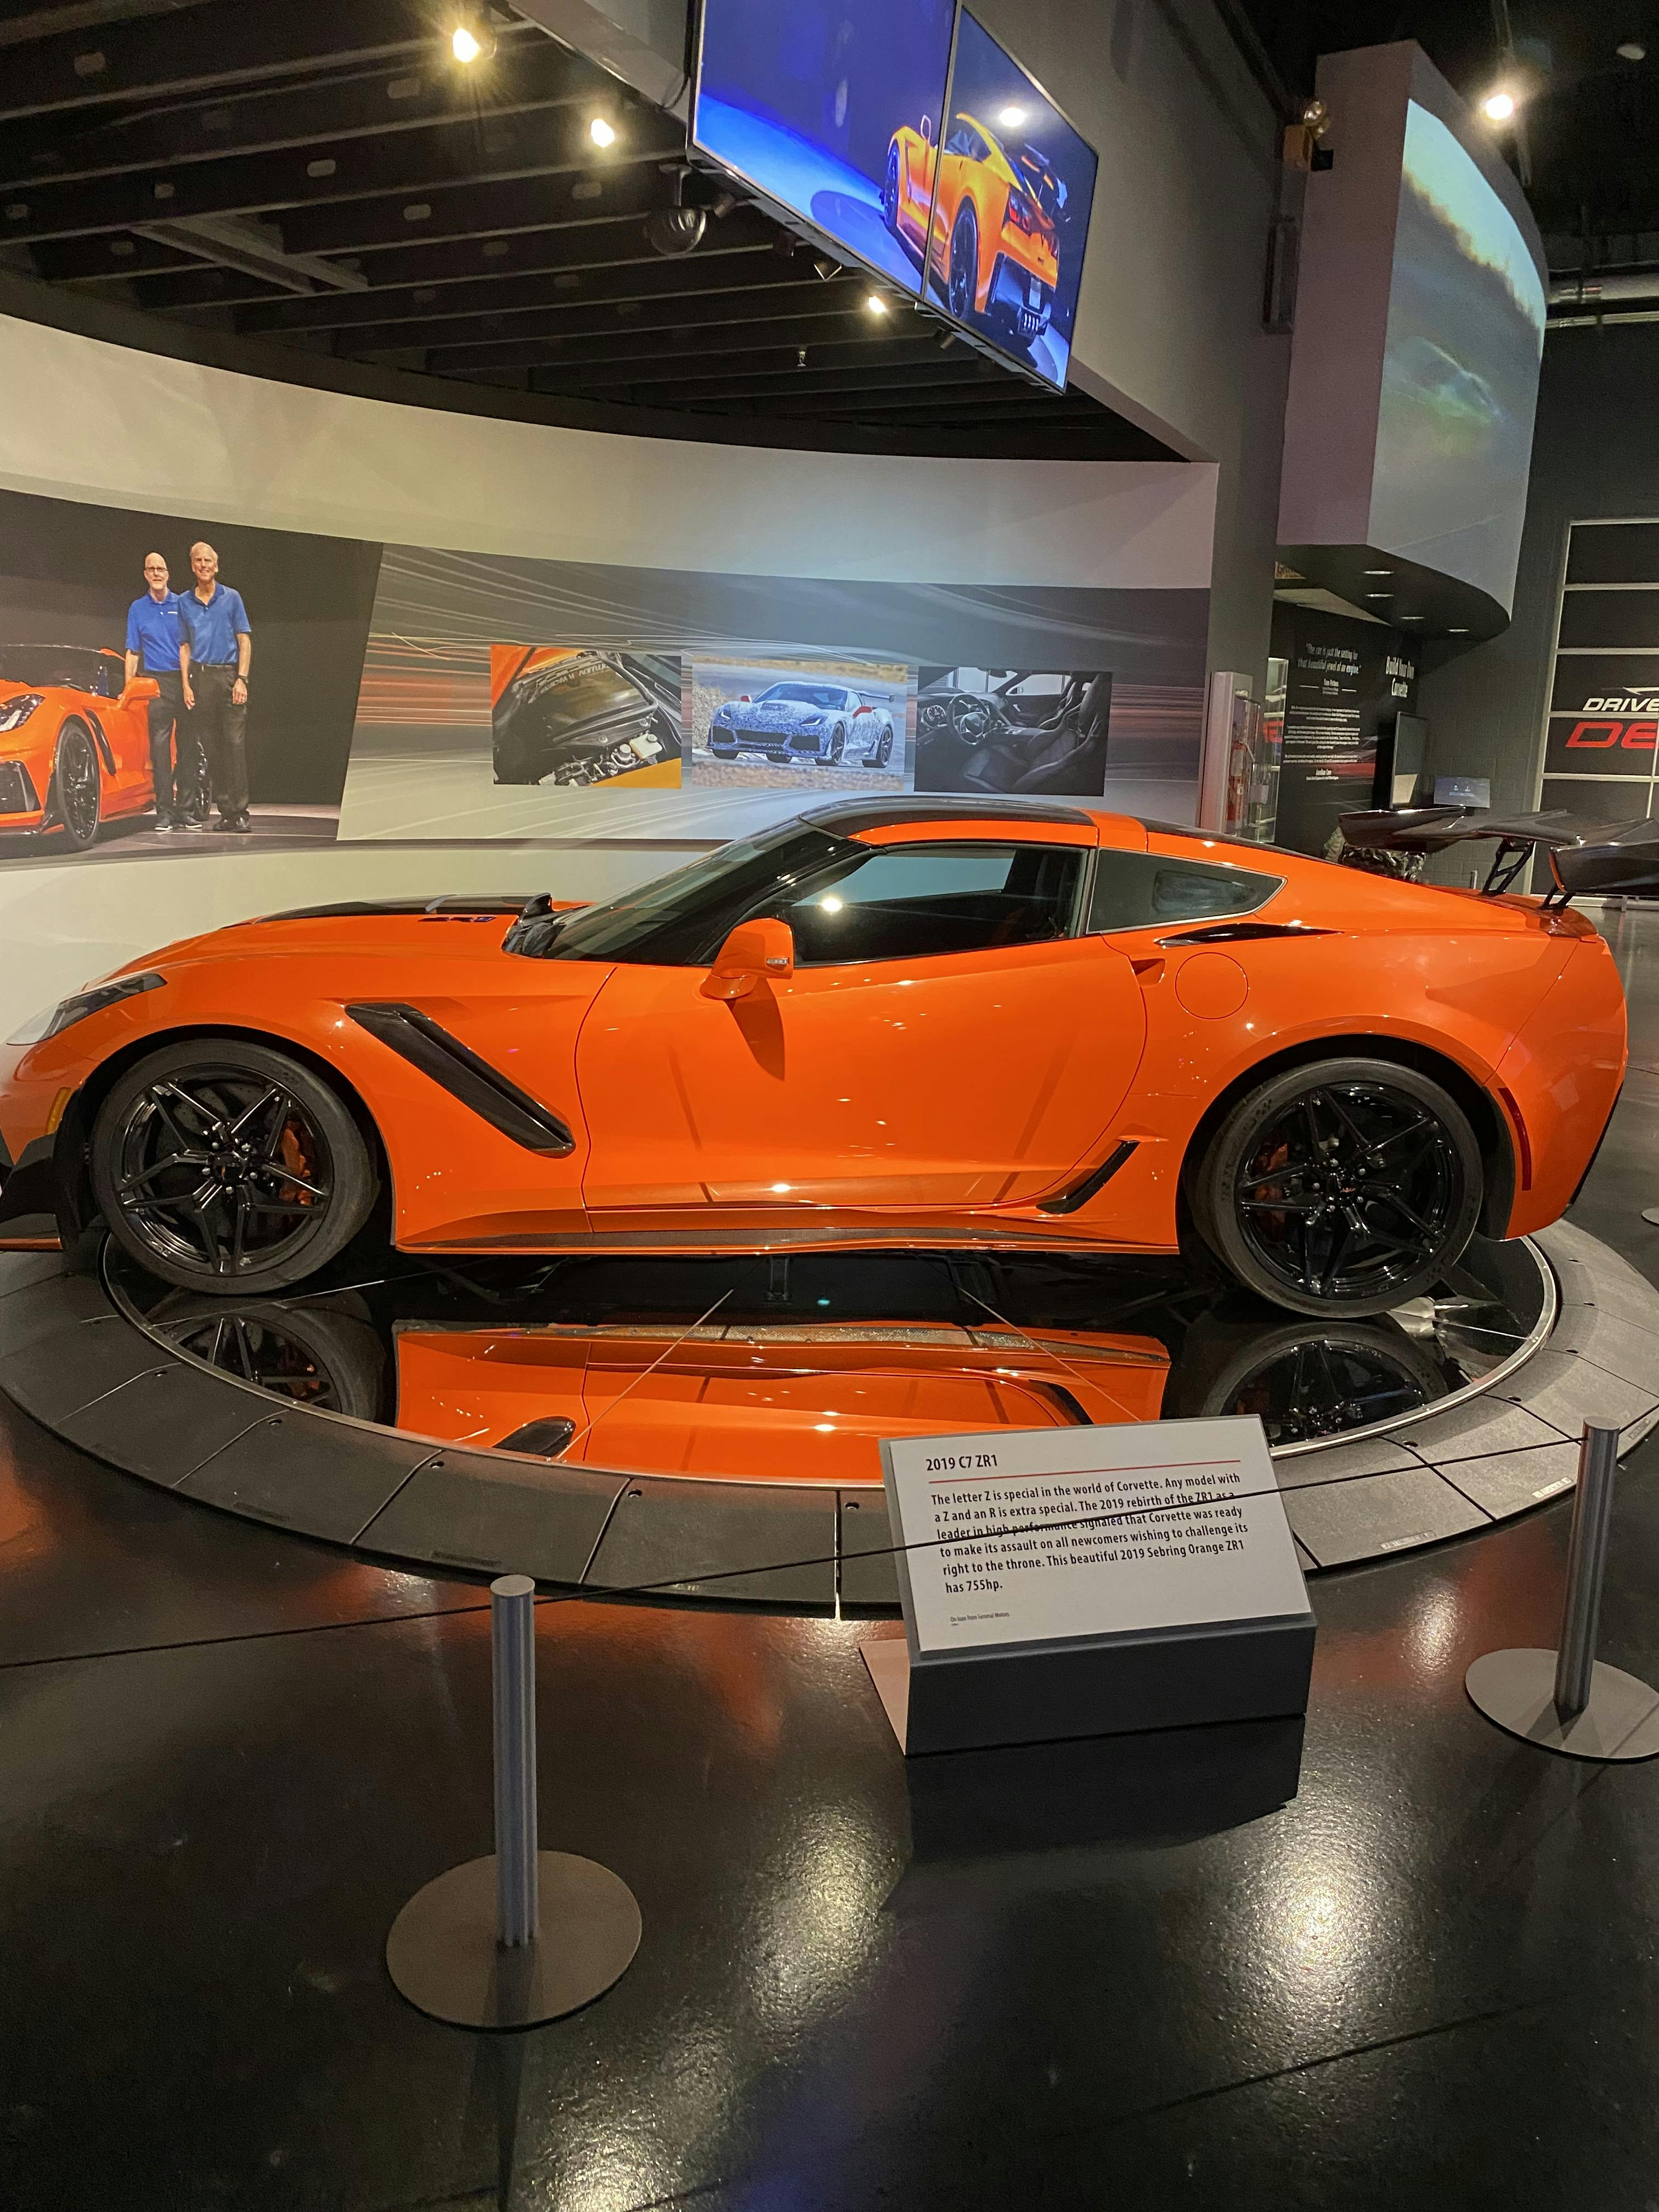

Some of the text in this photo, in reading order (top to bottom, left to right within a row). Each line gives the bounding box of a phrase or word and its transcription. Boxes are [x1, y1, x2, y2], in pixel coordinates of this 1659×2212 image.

[926, 1454, 997, 1471] 2019 C7 ZR1
[932, 1472, 1240, 1505] The letter Z is special in the world of Corvette. Any model with
[935, 1514, 940, 1522] a
[943, 1511, 949, 1521] Z
[952, 1509, 971, 1520] and
[974, 1510, 986, 1519] an
[990, 1508, 996, 1518] R
[998, 1507, 1007, 1517] is
[1009, 1505, 1036, 1516] extra
[1039, 1502, 1077, 1516] special.
[1079, 1500, 1097, 1511] The
[1101, 1498, 1124, 1510] 2019
[1127, 1496, 1162, 1508] rebirth
[1165, 1494, 1174, 1504] of
[1177, 1493, 1194, 1503] the
[1195, 1492, 1212, 1502] ZR1
[937, 1528, 970, 1539] leader
[973, 1526, 983, 1536] in
[986, 1523, 1008, 1537] high
[1080, 1516, 1122, 1530] signaled
[1125, 1514, 1147, 1525] that
[1149, 1510, 1191, 1523] Corvette
[1194, 1510, 1212, 1519] was
[1215, 1506, 1242, 1518] ready
[940, 1522, 1248, 1557] to make its assault on all newcomers wishing to challenge its
[943, 1540, 1244, 1577] right to the throne. This beautiful 2019 Sebring Orange ZR1
[945, 1579, 1003, 1593] has 755hp.
